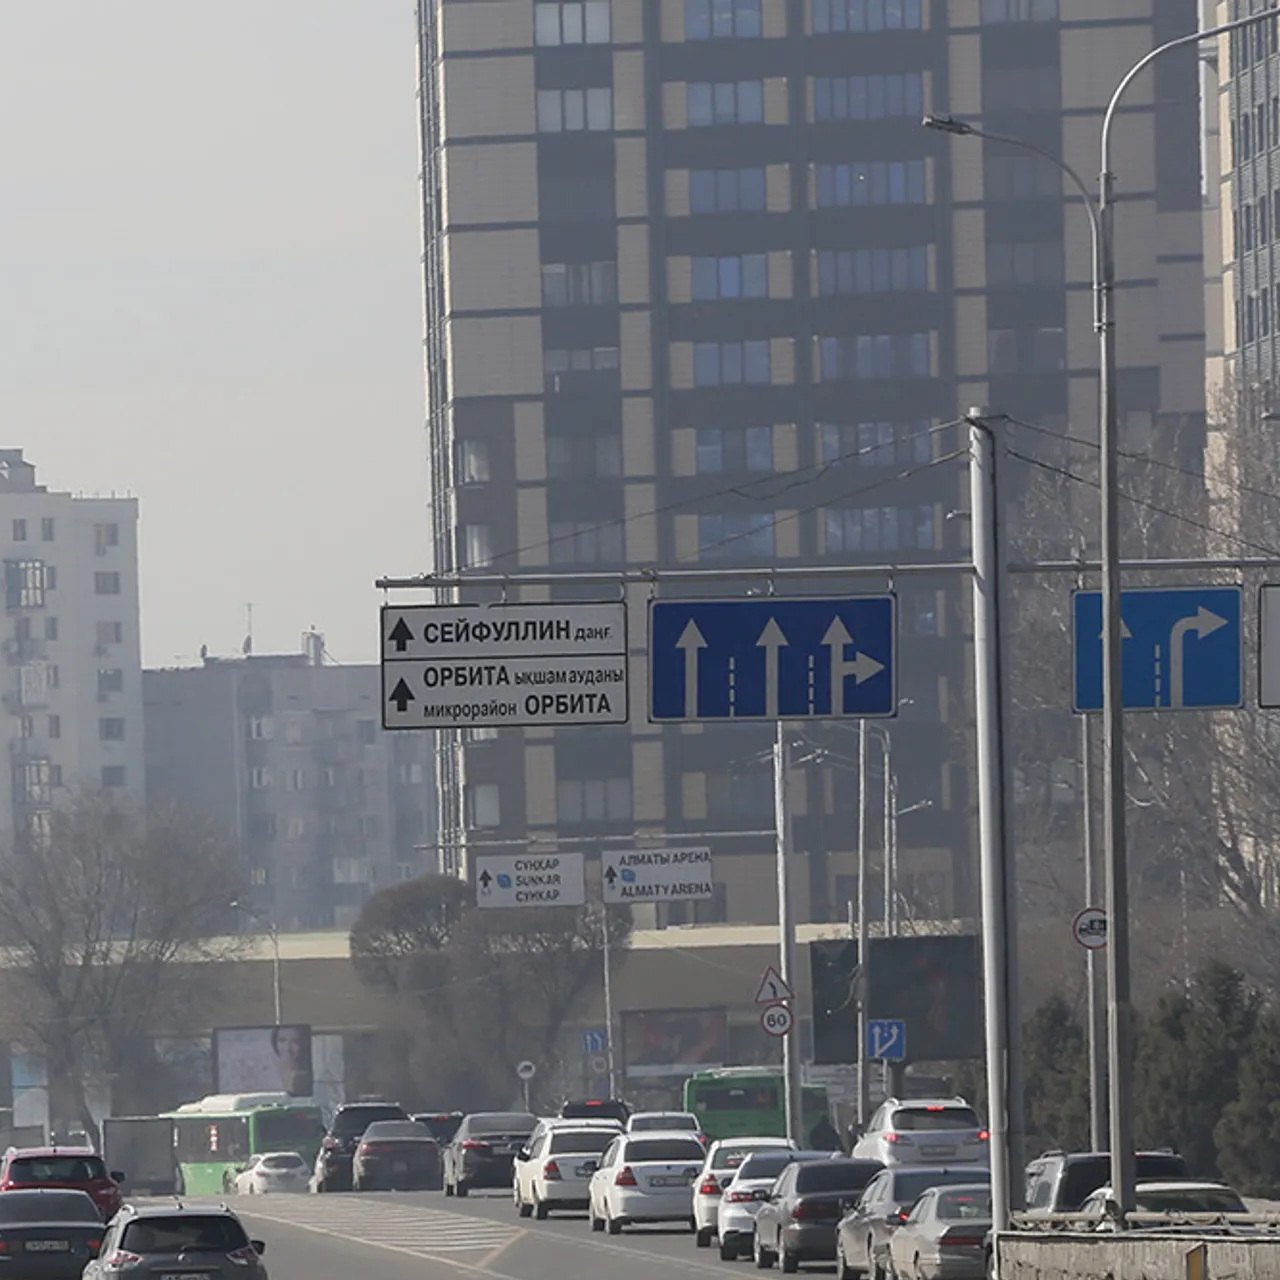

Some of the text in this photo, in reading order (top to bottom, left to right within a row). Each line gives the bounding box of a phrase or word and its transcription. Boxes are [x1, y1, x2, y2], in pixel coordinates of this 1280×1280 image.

[423, 618, 570, 643] СЕЙФУЛЛИН
[423, 666, 510, 687] ОРБИТА
[423, 694, 612, 721] микрорайон ОРБИТА
[620, 883, 712, 897] ALMATY ARENA
